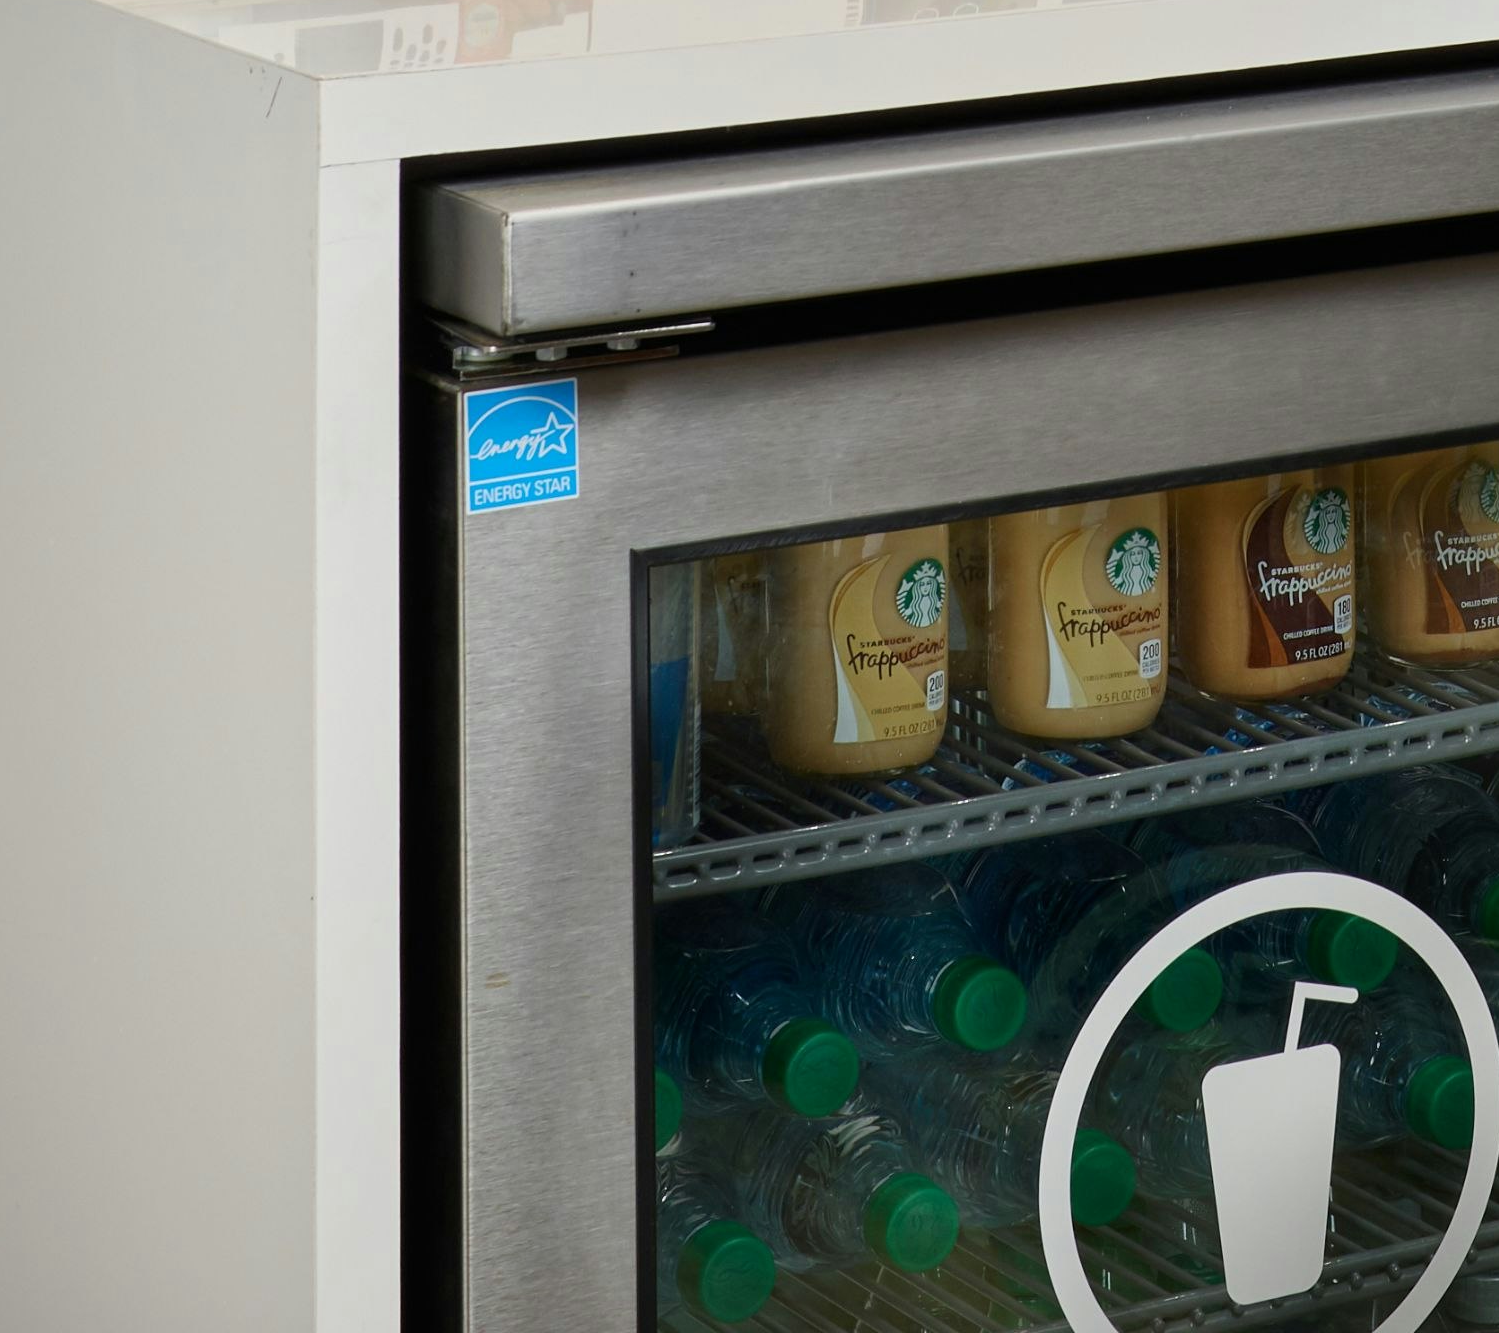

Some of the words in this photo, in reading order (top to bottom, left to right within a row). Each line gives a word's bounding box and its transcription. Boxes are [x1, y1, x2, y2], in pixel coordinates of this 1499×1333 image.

[474, 482, 531, 506] ENERGY
[535, 476, 571, 496] STAR
[1448, 533, 1497, 546] STARBUCKS
[1271, 562, 1320, 576] STARBUCKS
[1257, 560, 1352, 607] frappuccino
[1071, 604, 1125, 616] STARBUCKS
[1337, 599, 1351, 614] 180
[1058, 601, 1161, 647] frappuccino
[1474, 617, 1486, 629] 9.5
[1488, 615, 1496, 628] FL
[860, 636, 913, 649] STARBUCKS
[1142, 642, 1160, 660] 200
[847, 634, 945, 681] frappuccino
[1295, 647, 1308, 661] 9.5
[1308, 645, 1317, 659] FL
[1318, 644, 1328, 658] OZ
[929, 675, 944, 693] 200
